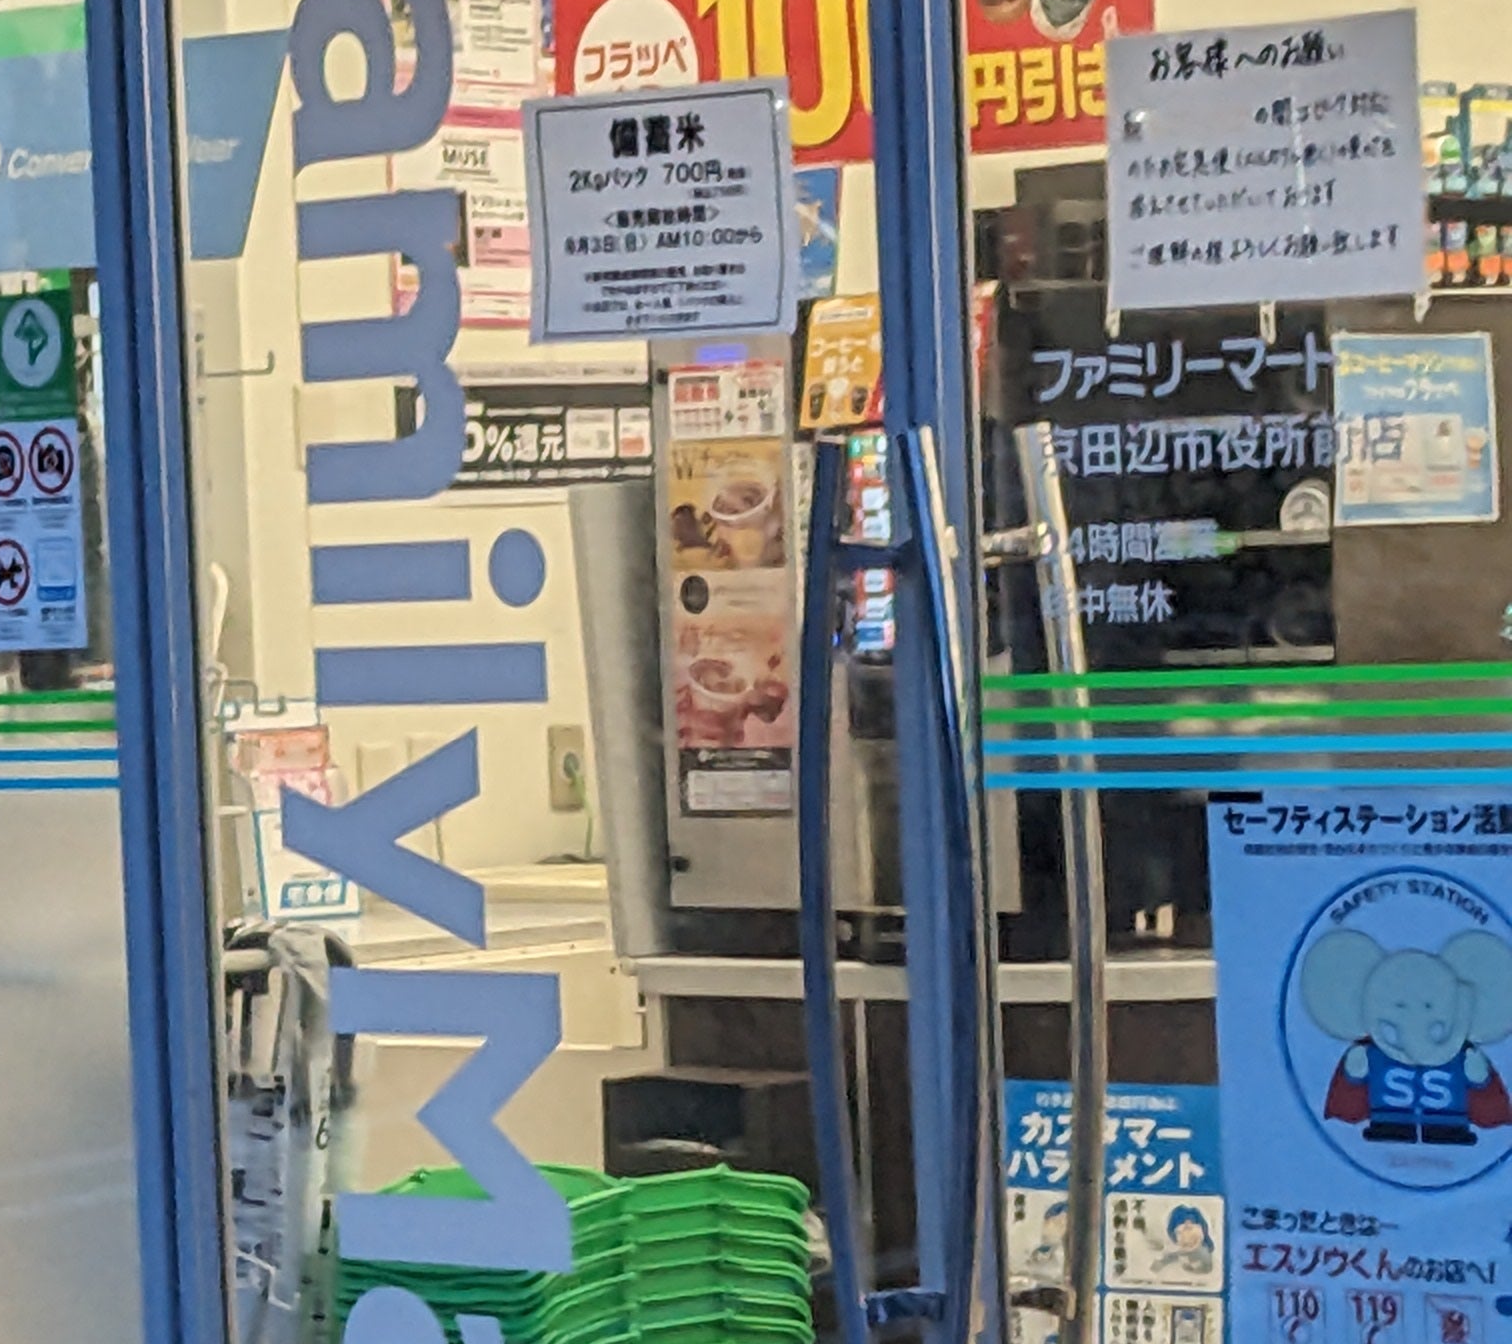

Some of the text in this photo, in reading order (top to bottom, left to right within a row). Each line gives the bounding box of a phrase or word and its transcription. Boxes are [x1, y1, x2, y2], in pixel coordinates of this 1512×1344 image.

[582, 35, 688, 83] フラッペ
[1033, 331, 1336, 402] ファミリーマート
[1070, 518, 1221, 564] 4時間営業
[1382, 1068, 1454, 1109] SS
[1007, 1150, 1205, 1189] ハラメント
